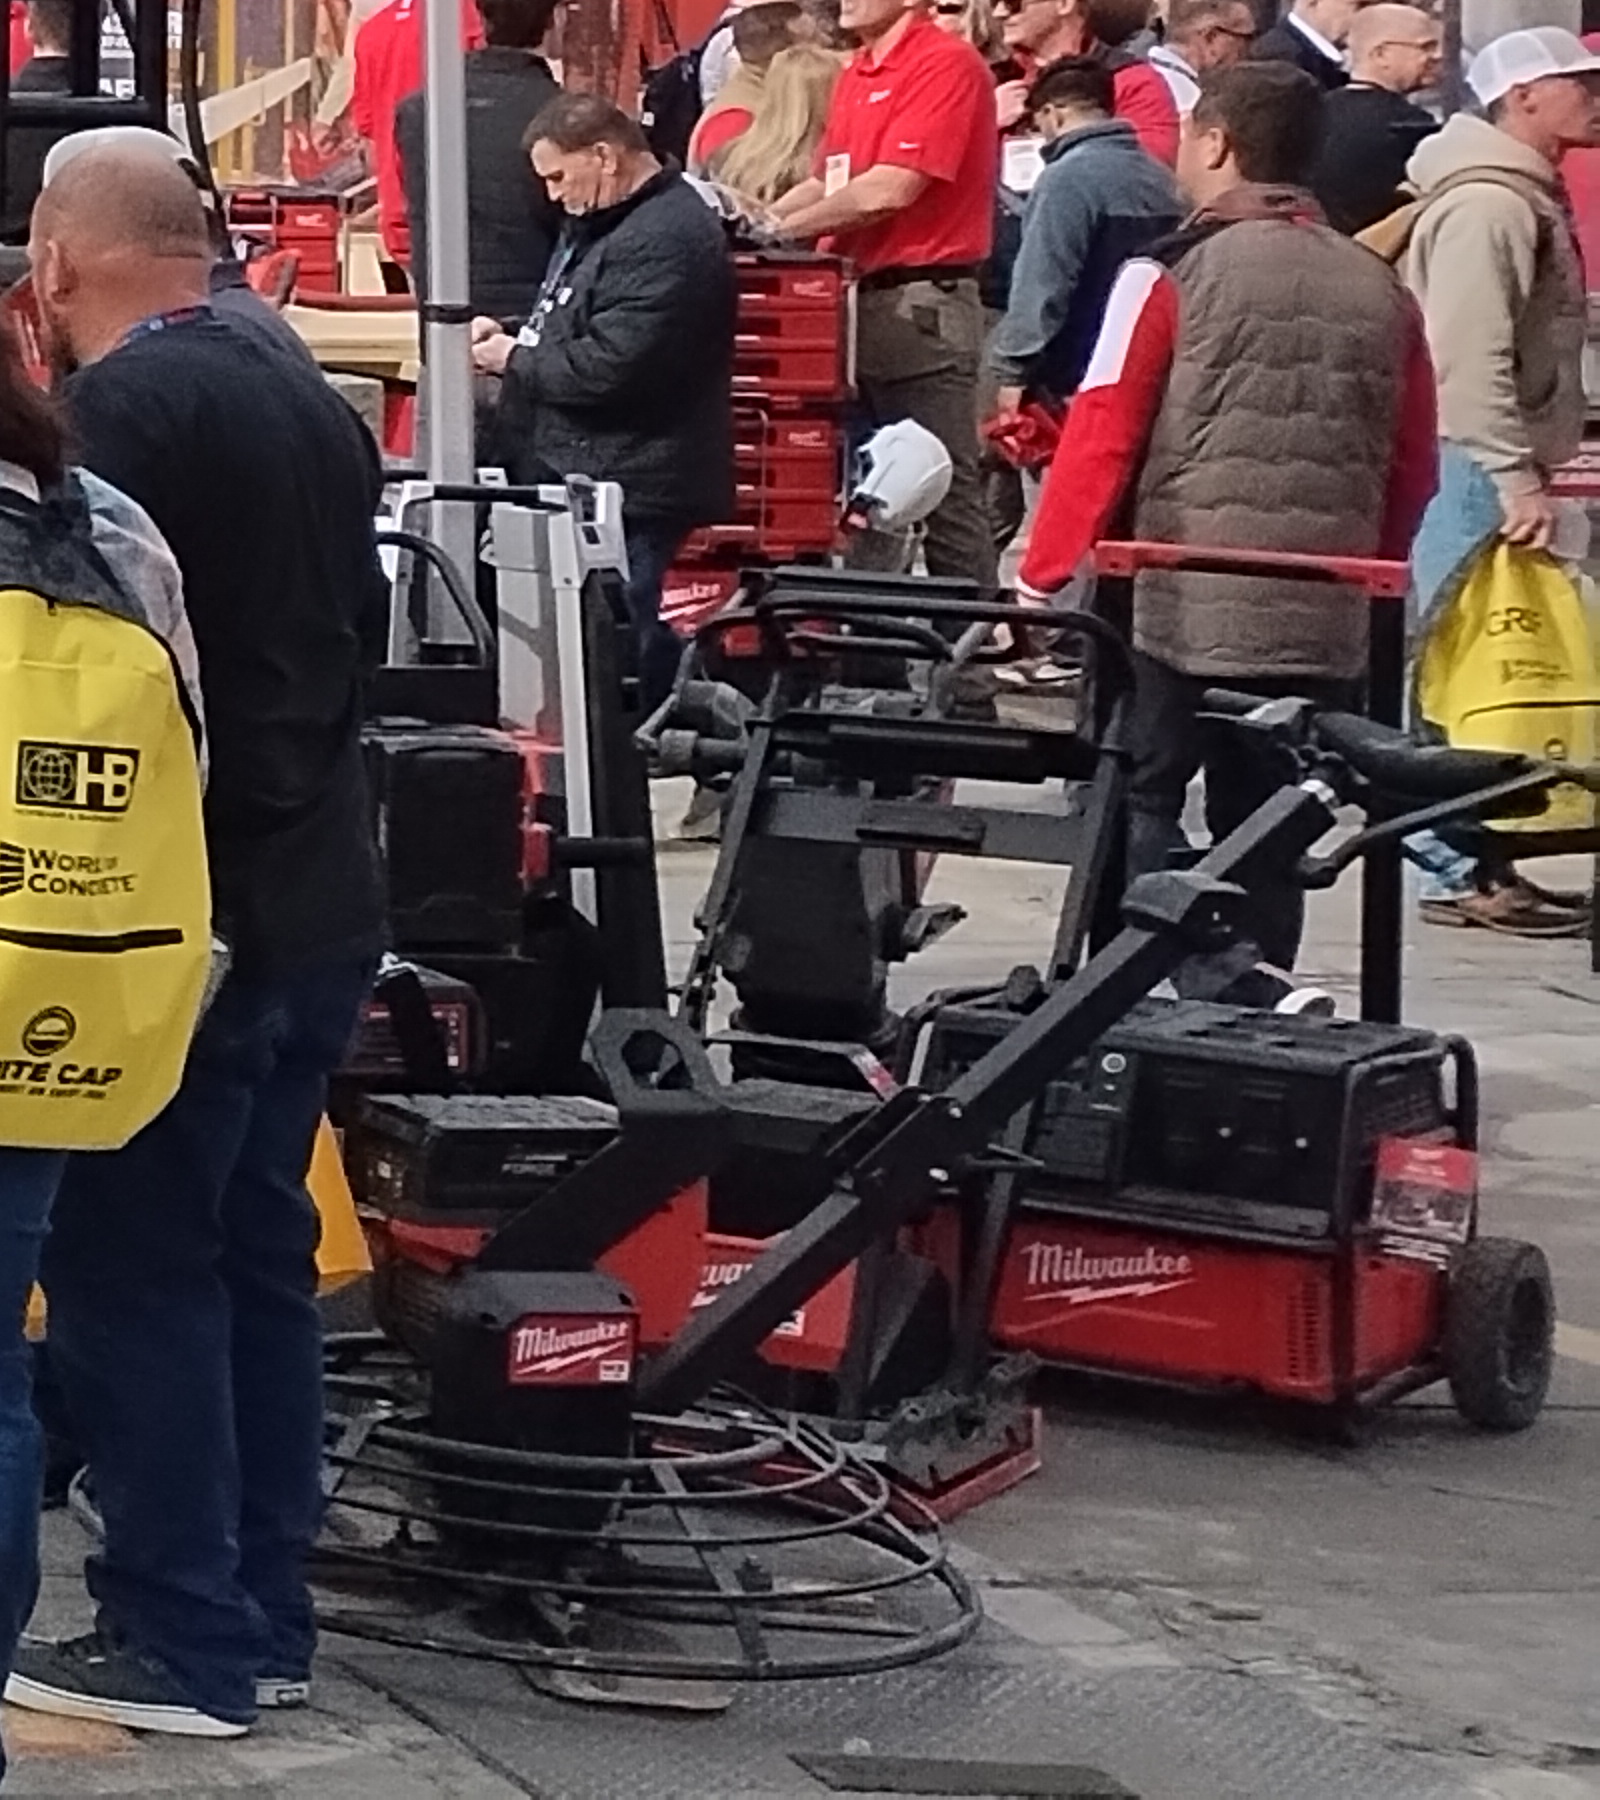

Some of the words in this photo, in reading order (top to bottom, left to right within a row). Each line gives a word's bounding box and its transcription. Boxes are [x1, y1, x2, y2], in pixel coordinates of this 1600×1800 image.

[57, 1063, 123, 1086] CAP
[1020, 1241, 1192, 1284] Milwaukee
[517, 1322, 628, 1362] Milwaukee
